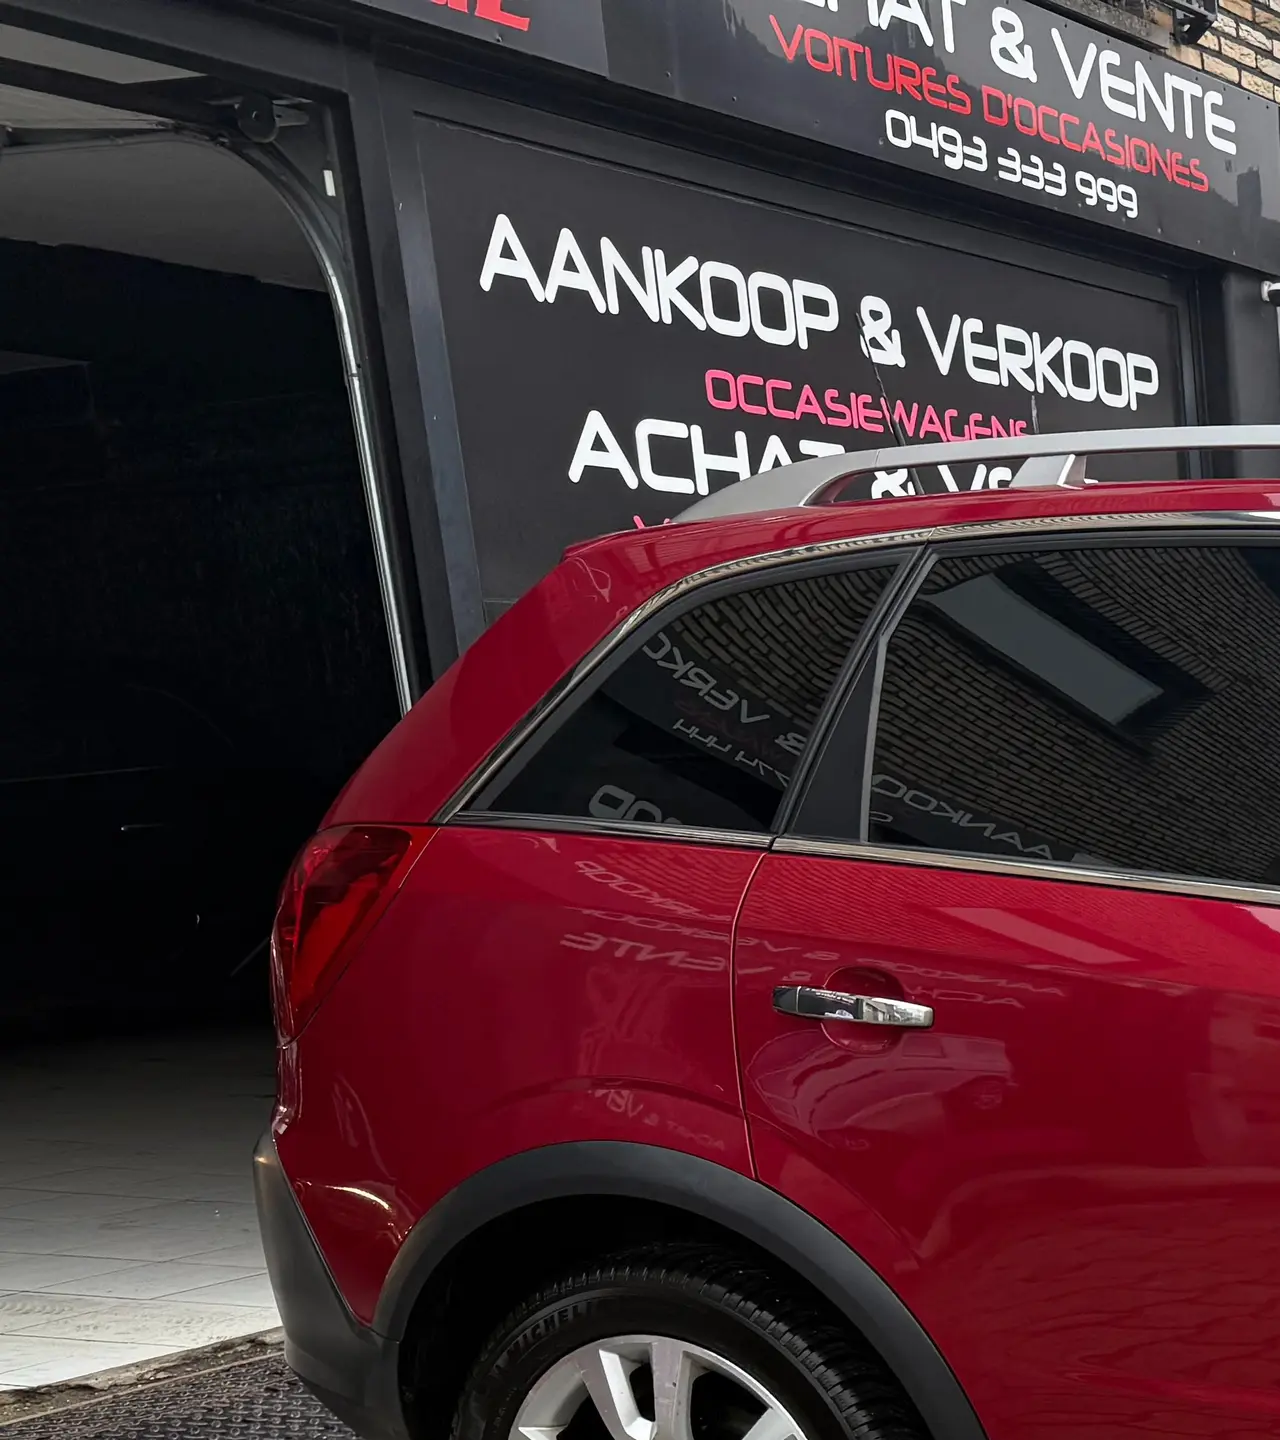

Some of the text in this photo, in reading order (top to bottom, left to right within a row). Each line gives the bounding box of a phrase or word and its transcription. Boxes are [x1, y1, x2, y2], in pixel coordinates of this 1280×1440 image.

[769, 15, 1208, 192] VOITURES D'OCCASIONES
[990, 6, 1037, 83] &
[1051, 28, 1236, 155] VENTE
[885, 109, 1138, 218] 0493 333 999
[480, 213, 1159, 411] AANKOOP & VERKOOP
[705, 368, 1028, 442] OCCASIEWAGENS
